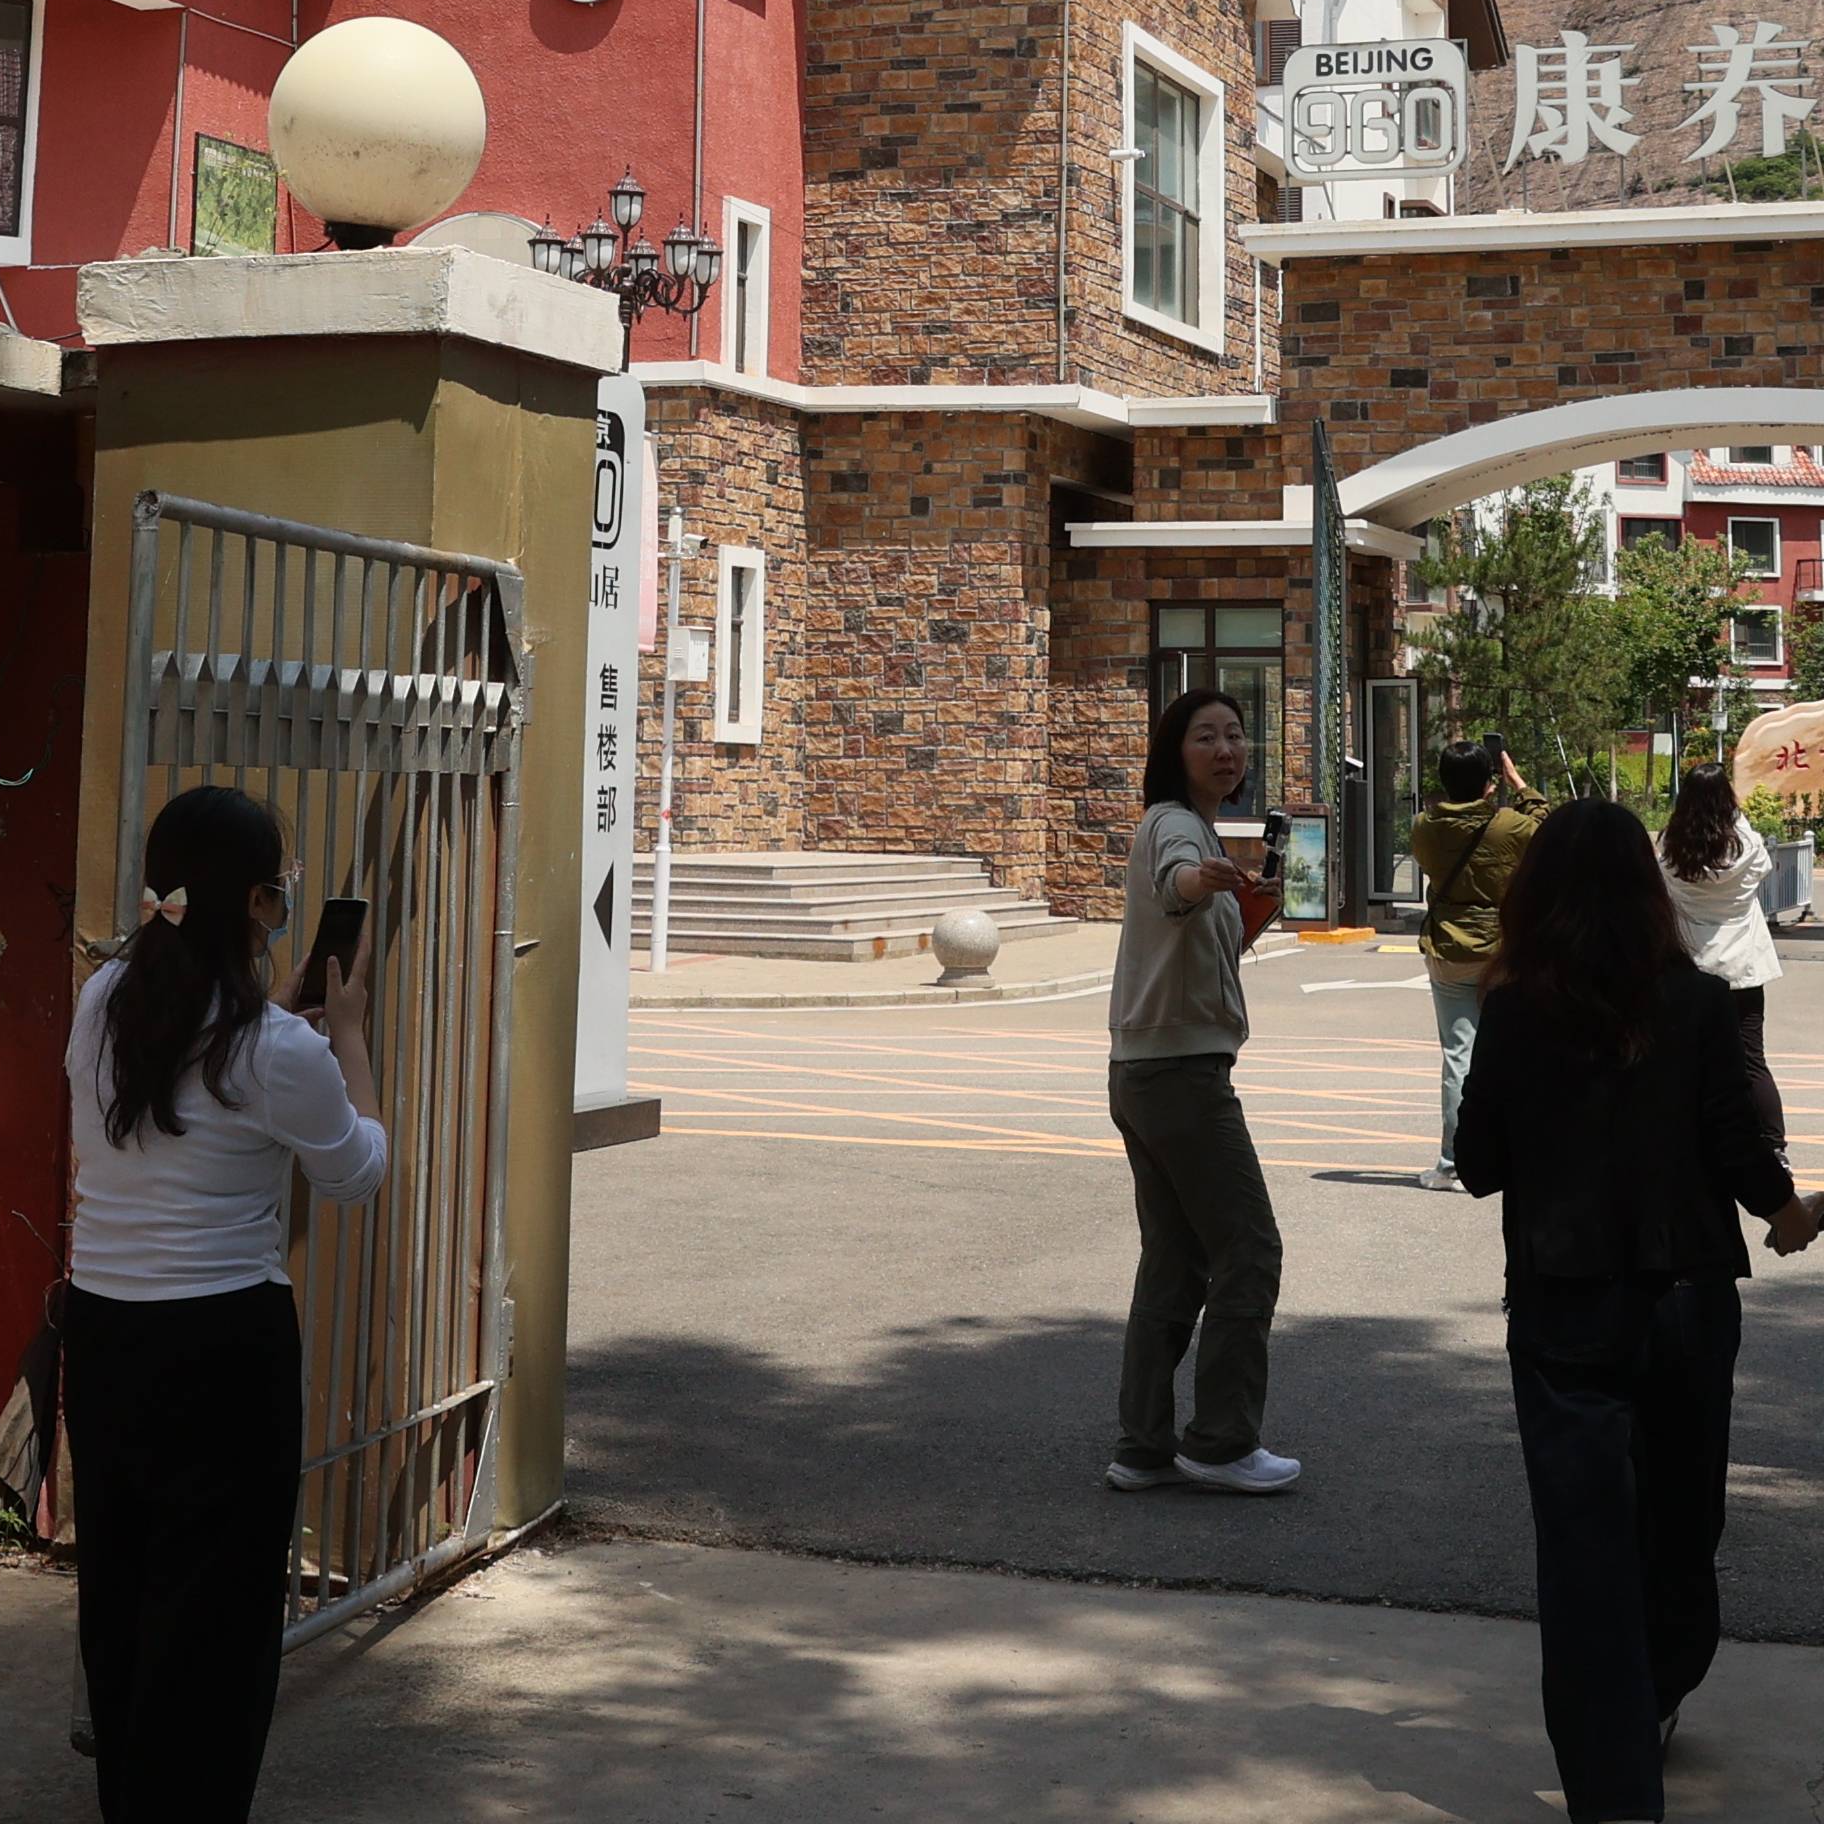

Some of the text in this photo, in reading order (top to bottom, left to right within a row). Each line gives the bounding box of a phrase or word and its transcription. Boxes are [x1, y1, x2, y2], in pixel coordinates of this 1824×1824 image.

[1315, 47, 1434, 77] BEIJING
[1297, 87, 1454, 166] 960
[596, 662, 619, 833] 售楼部
